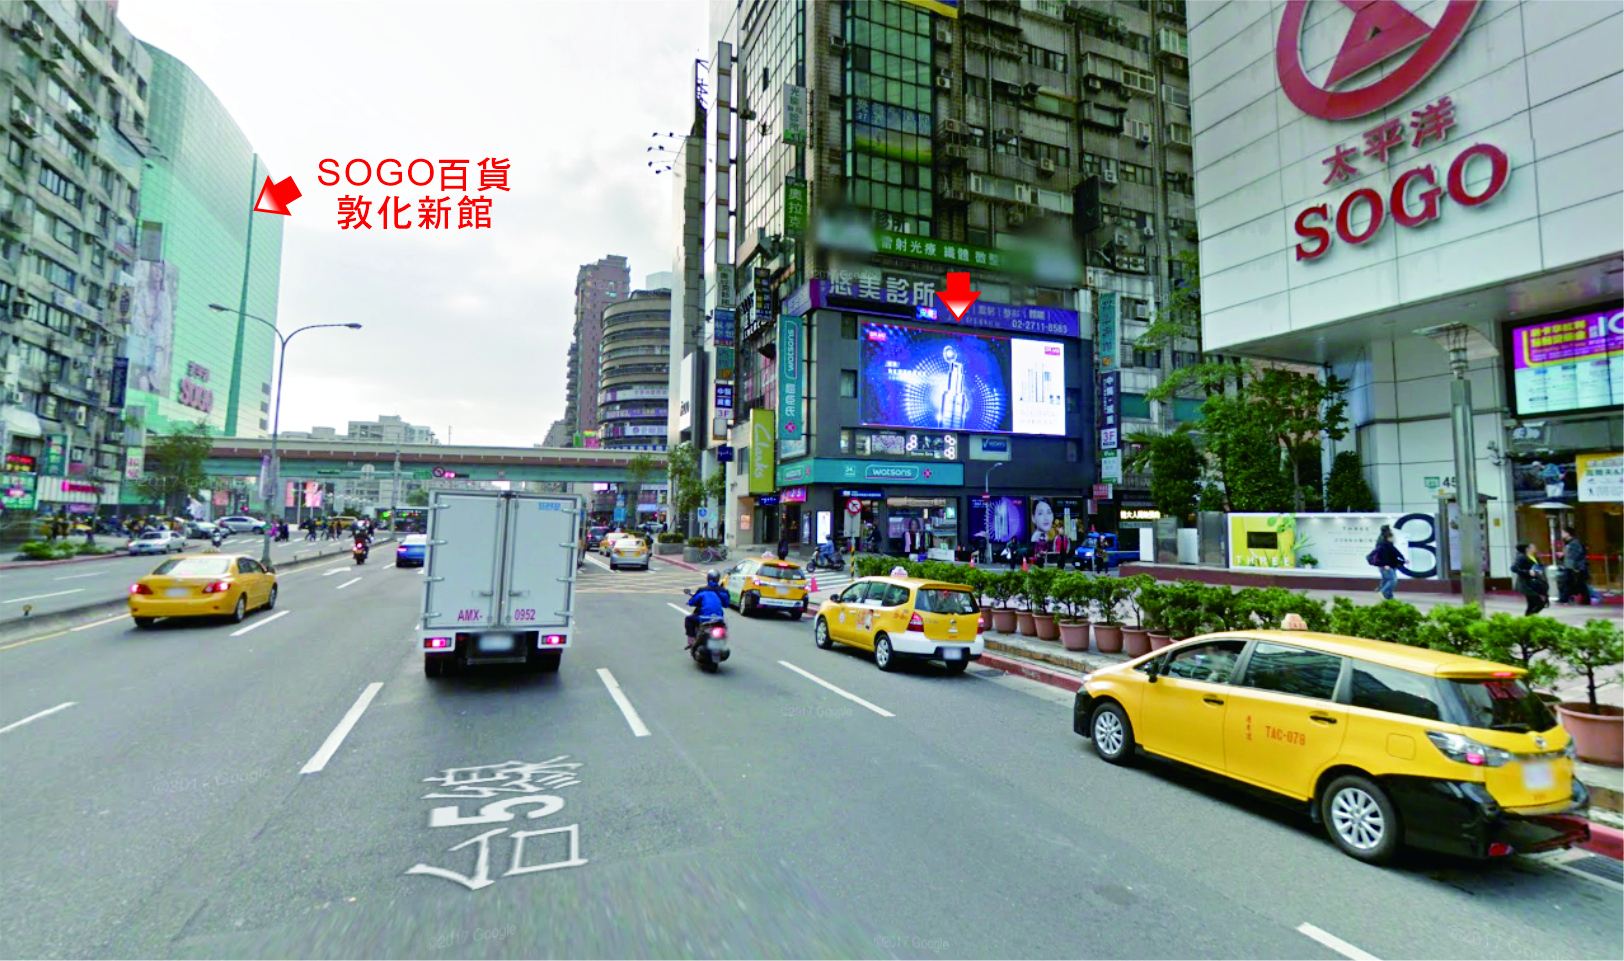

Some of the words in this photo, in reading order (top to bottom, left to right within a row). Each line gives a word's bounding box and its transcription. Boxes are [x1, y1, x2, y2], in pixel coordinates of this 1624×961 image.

[1322, 96, 1455, 186] 太平洋
[1295, 143, 1510, 262] SOGO
[787, 328, 795, 372] watsons
[1103, 432, 1115, 442] 3F
[872, 468, 912, 477] watsons
[1393, 513, 1438, 578] 3
[1235, 555, 1291, 567] THREE
[457, 609, 483, 622] AMX-
[514, 608, 536, 621] 0952
